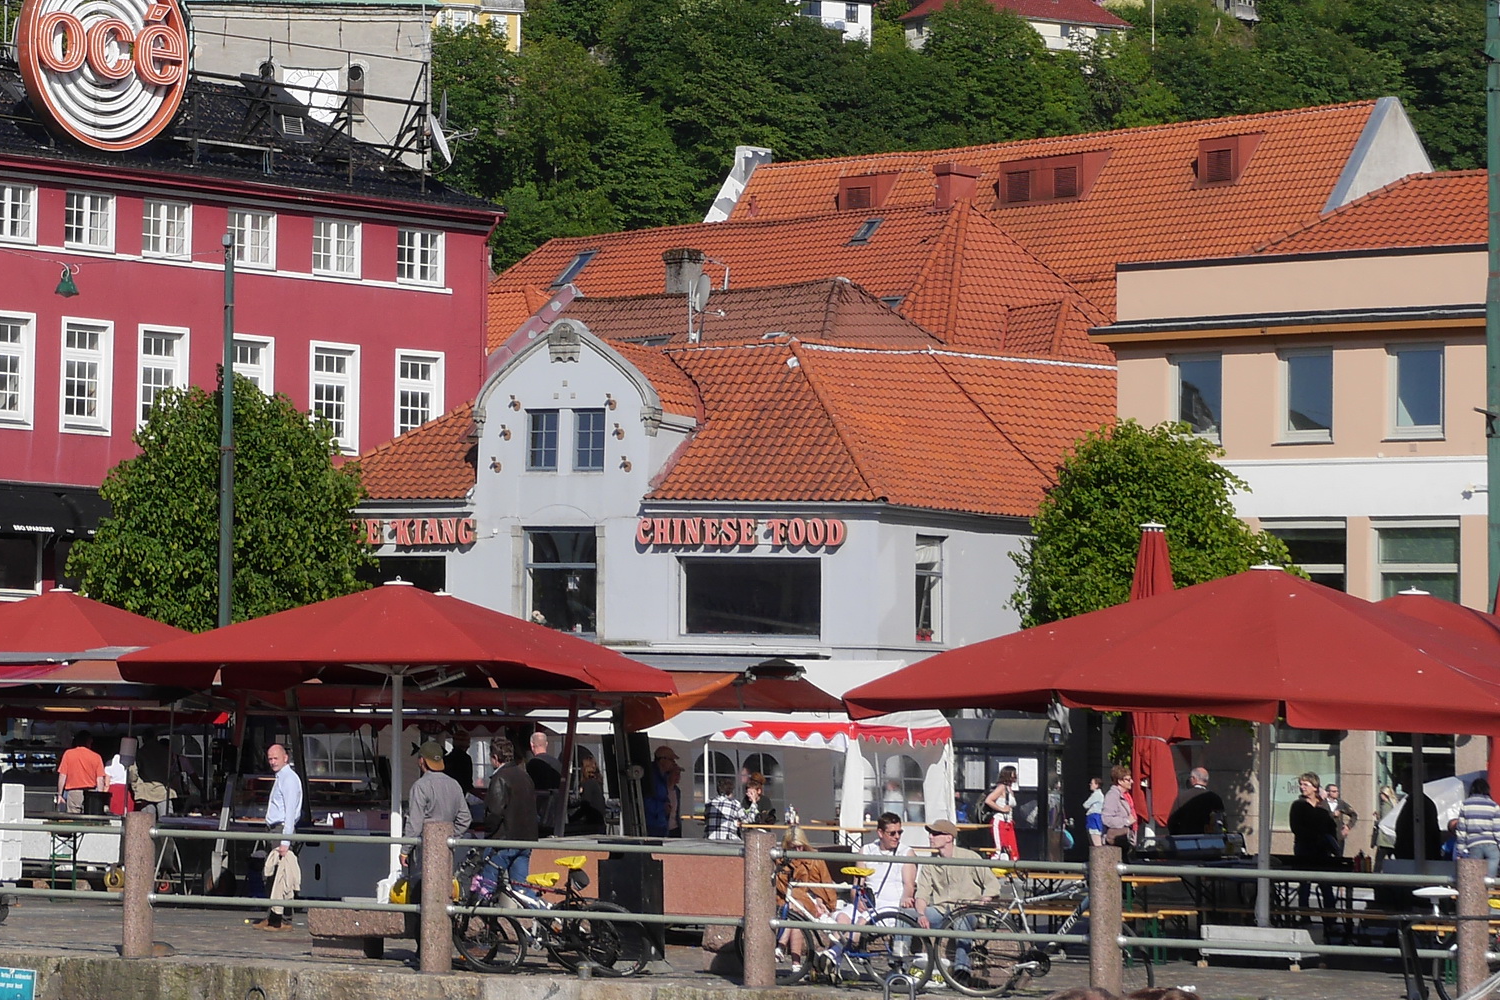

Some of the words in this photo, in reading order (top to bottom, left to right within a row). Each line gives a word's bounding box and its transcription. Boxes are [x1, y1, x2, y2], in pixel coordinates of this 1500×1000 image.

[388, 517, 477, 546] KIANG
[636, 516, 757, 546] CHINESE
[766, 517, 847, 546] FOOD
